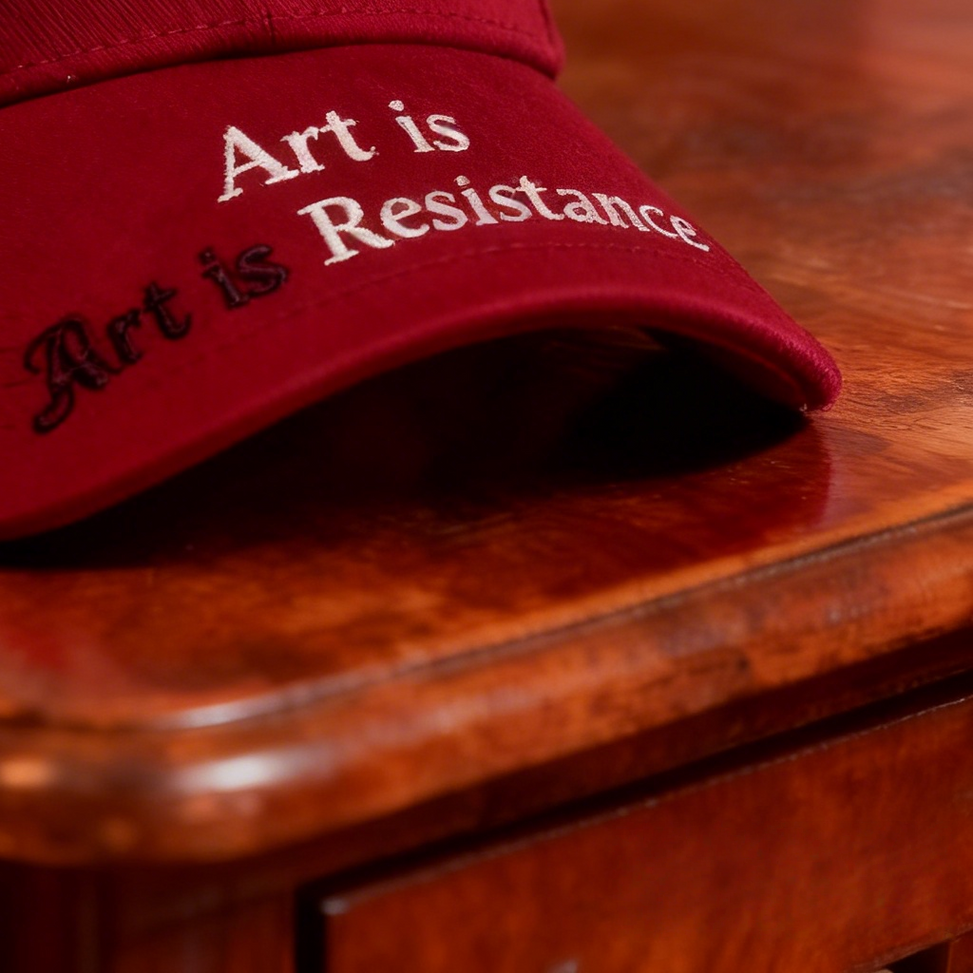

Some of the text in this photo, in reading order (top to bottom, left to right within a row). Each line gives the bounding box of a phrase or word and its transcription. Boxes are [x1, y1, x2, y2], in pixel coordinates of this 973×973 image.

[217, 100, 471, 203] Art is
[298, 175, 710, 266] Resistance
[23, 245, 290, 432] Art is
